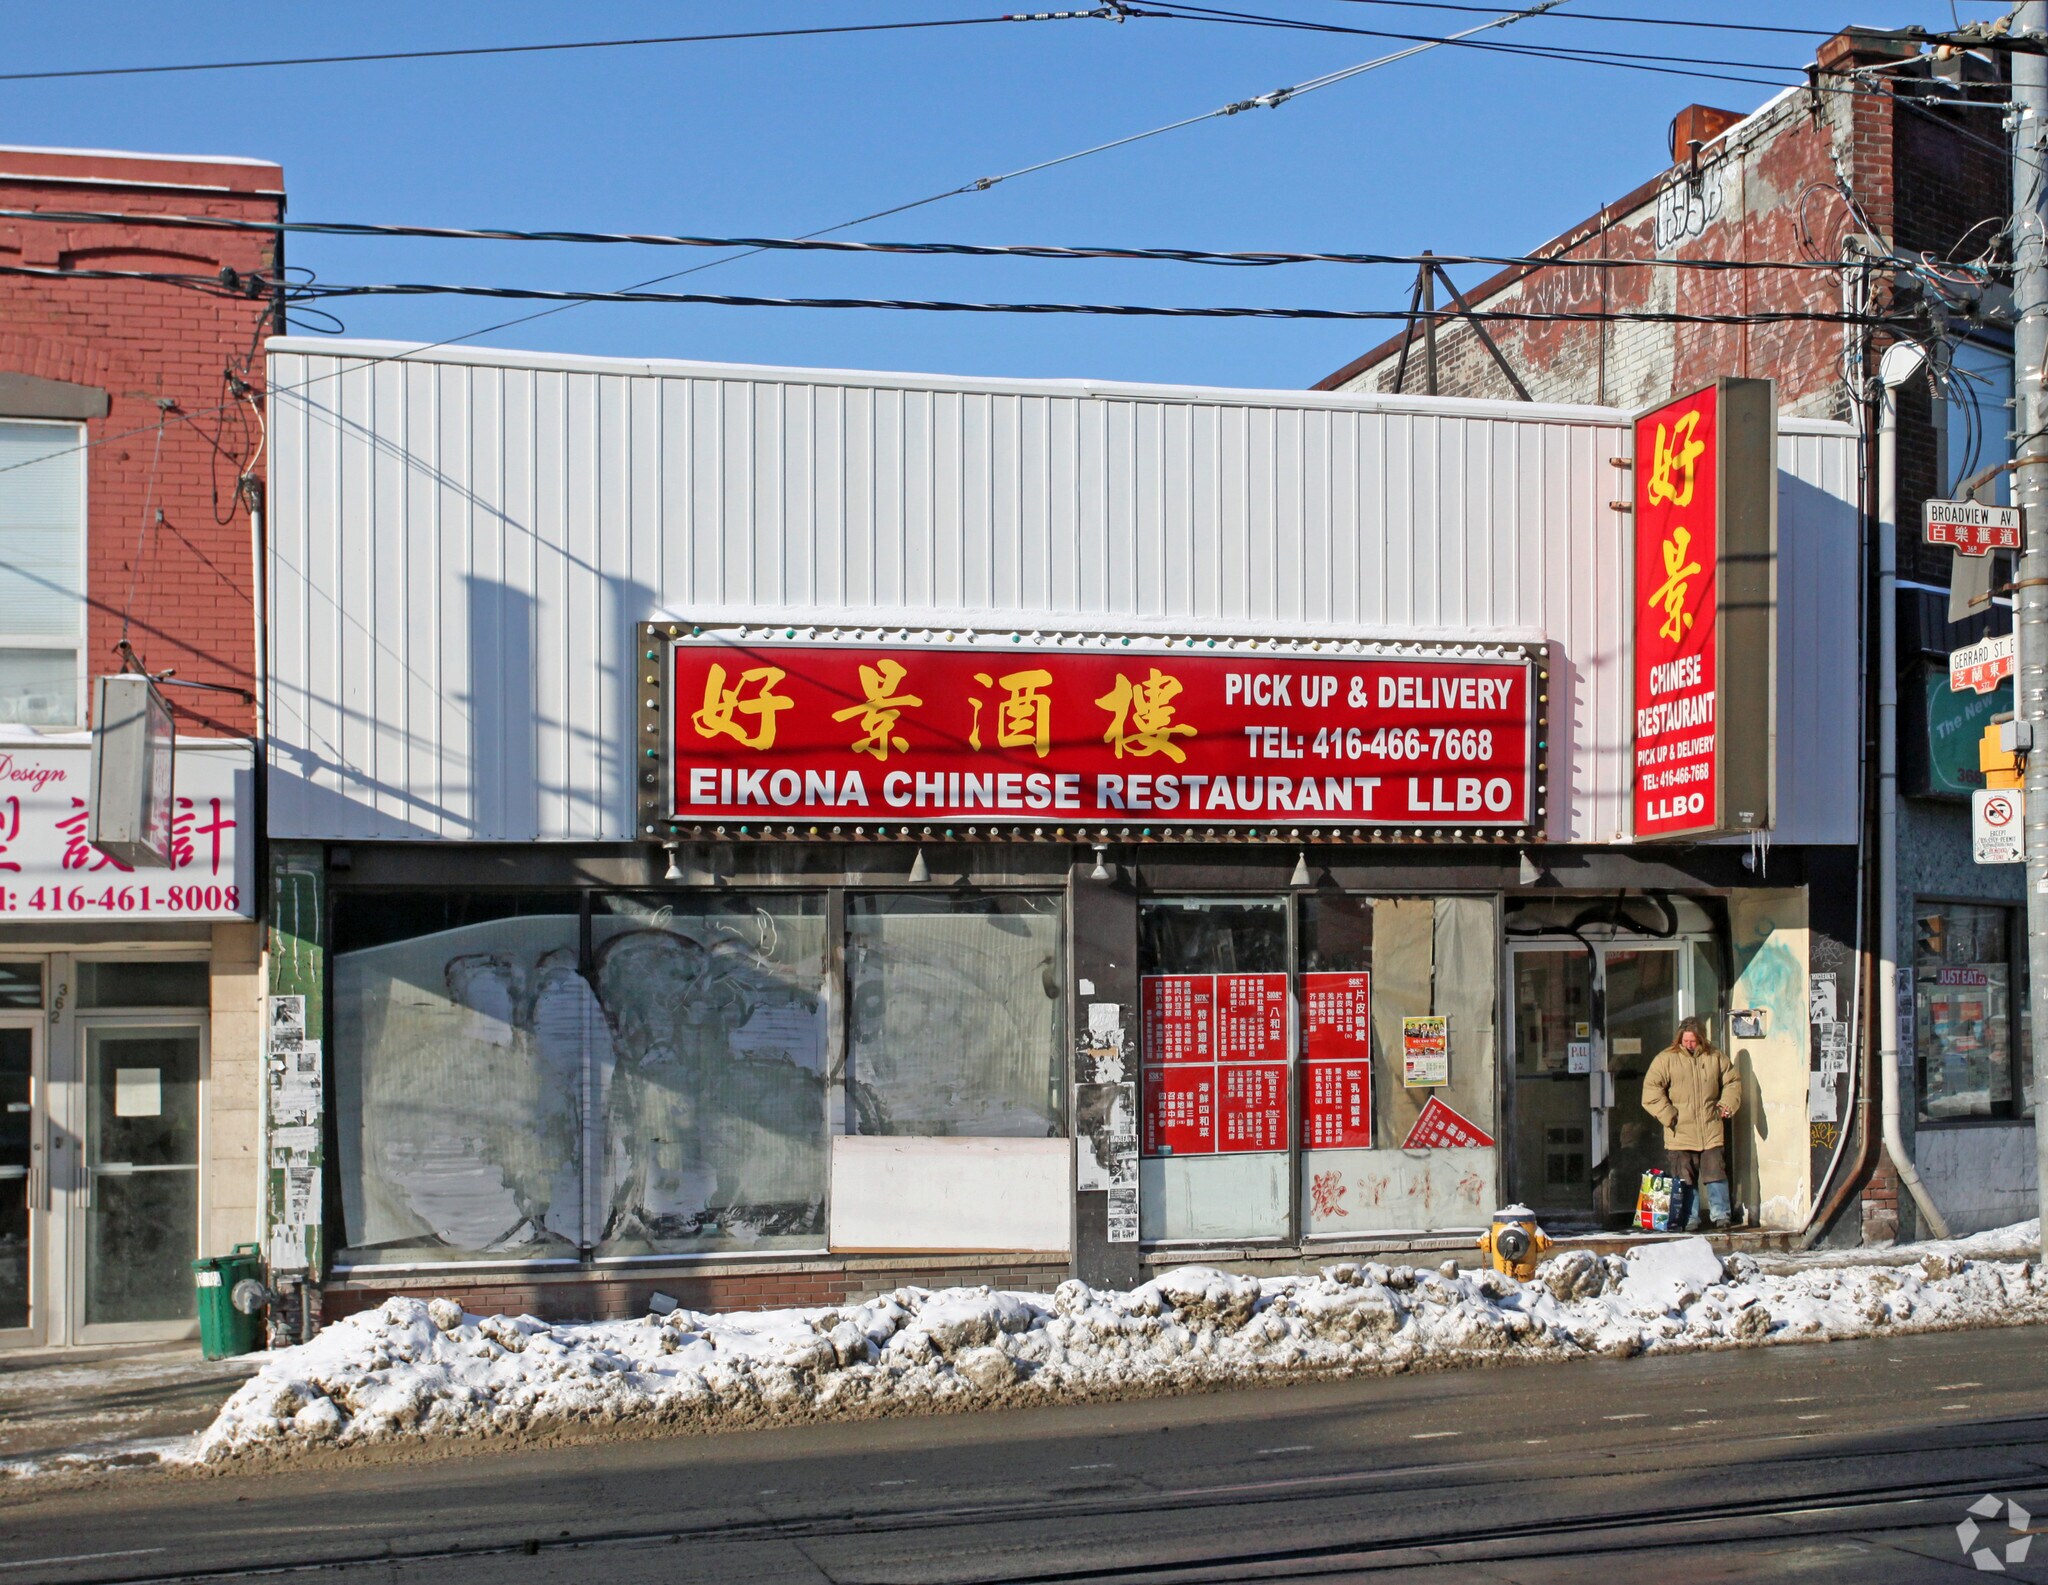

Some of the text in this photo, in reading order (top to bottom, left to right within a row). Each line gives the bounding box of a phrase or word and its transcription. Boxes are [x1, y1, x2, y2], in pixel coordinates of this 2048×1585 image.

[1648, 410, 1704, 643] 好景
[1932, 506, 2013, 527] BROADVIEW AV.
[1954, 646, 1988, 669] GERRARD
[1994, 642, 2005, 657] ST.
[1226, 674, 1512, 709] PICK UP & DELIVERY
[1650, 654, 1701, 696] CHINESE
[691, 659, 1198, 764] 好景酒樓
[1638, 691, 1714, 738] RESTAURANT
[1937, 696, 1993, 740] The New
[1244, 726, 1492, 760] TEL: 416-466-7668
[1638, 735, 1715, 767] PICK UP & DELIVERY
[690, 768, 1512, 812] EIKONA CHINESE RESTAURANT LLBO
[1643, 763, 1709, 791] TEL: 416-466-7668
[1647, 793, 1704, 821] LLBO
[28, 885, 240, 911] 416-461-8008
[1939, 969, 1961, 985] JUST
[1270, 1007, 1280, 1040] 八和菜
[1356, 990, 1365, 1041] 片皮鴨餐
[1199, 1083, 1209, 1136] 海鮮四和菜
